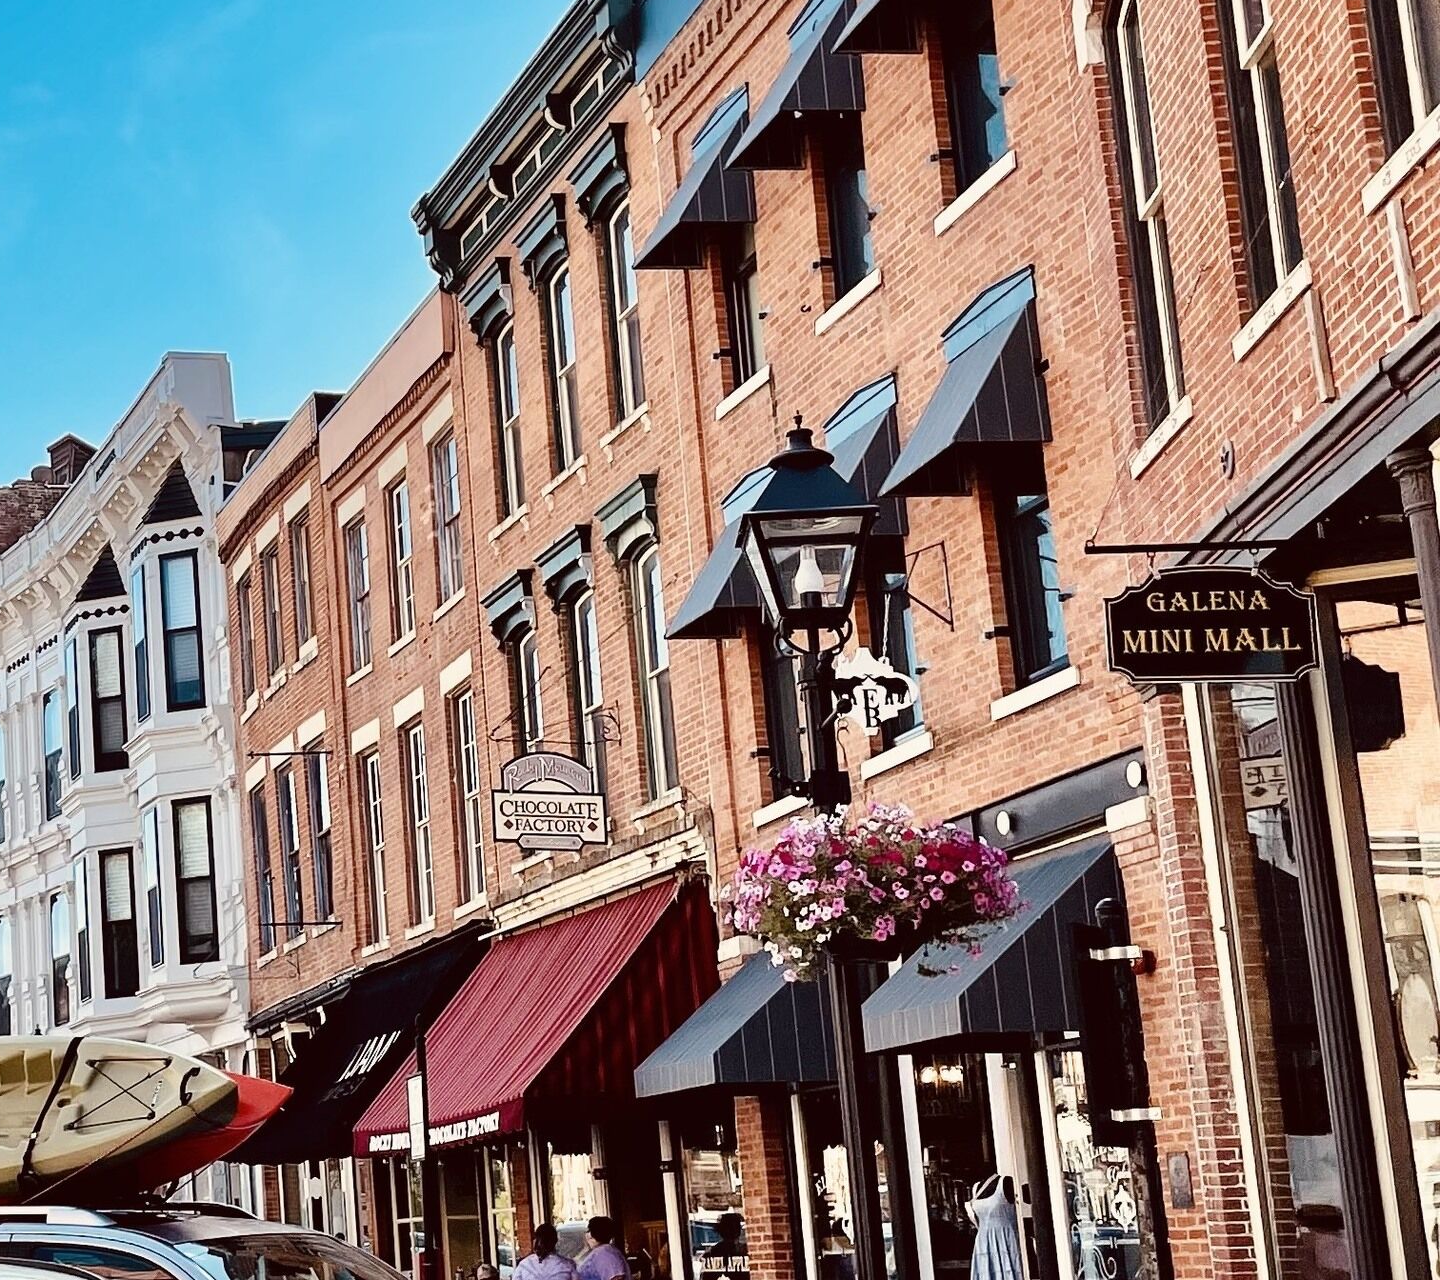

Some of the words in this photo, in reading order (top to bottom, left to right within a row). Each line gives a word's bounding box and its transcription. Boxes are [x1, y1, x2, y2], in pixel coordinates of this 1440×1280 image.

[1146, 590, 1271, 612] GALENA
[1122, 629, 1194, 654] MINI
[1204, 626, 1303, 653] MALL
[500, 800, 599, 820] CHOCOLATE
[515, 819, 586, 832] FACTORY
[428, 1121, 467, 1146] HOCOLATE
